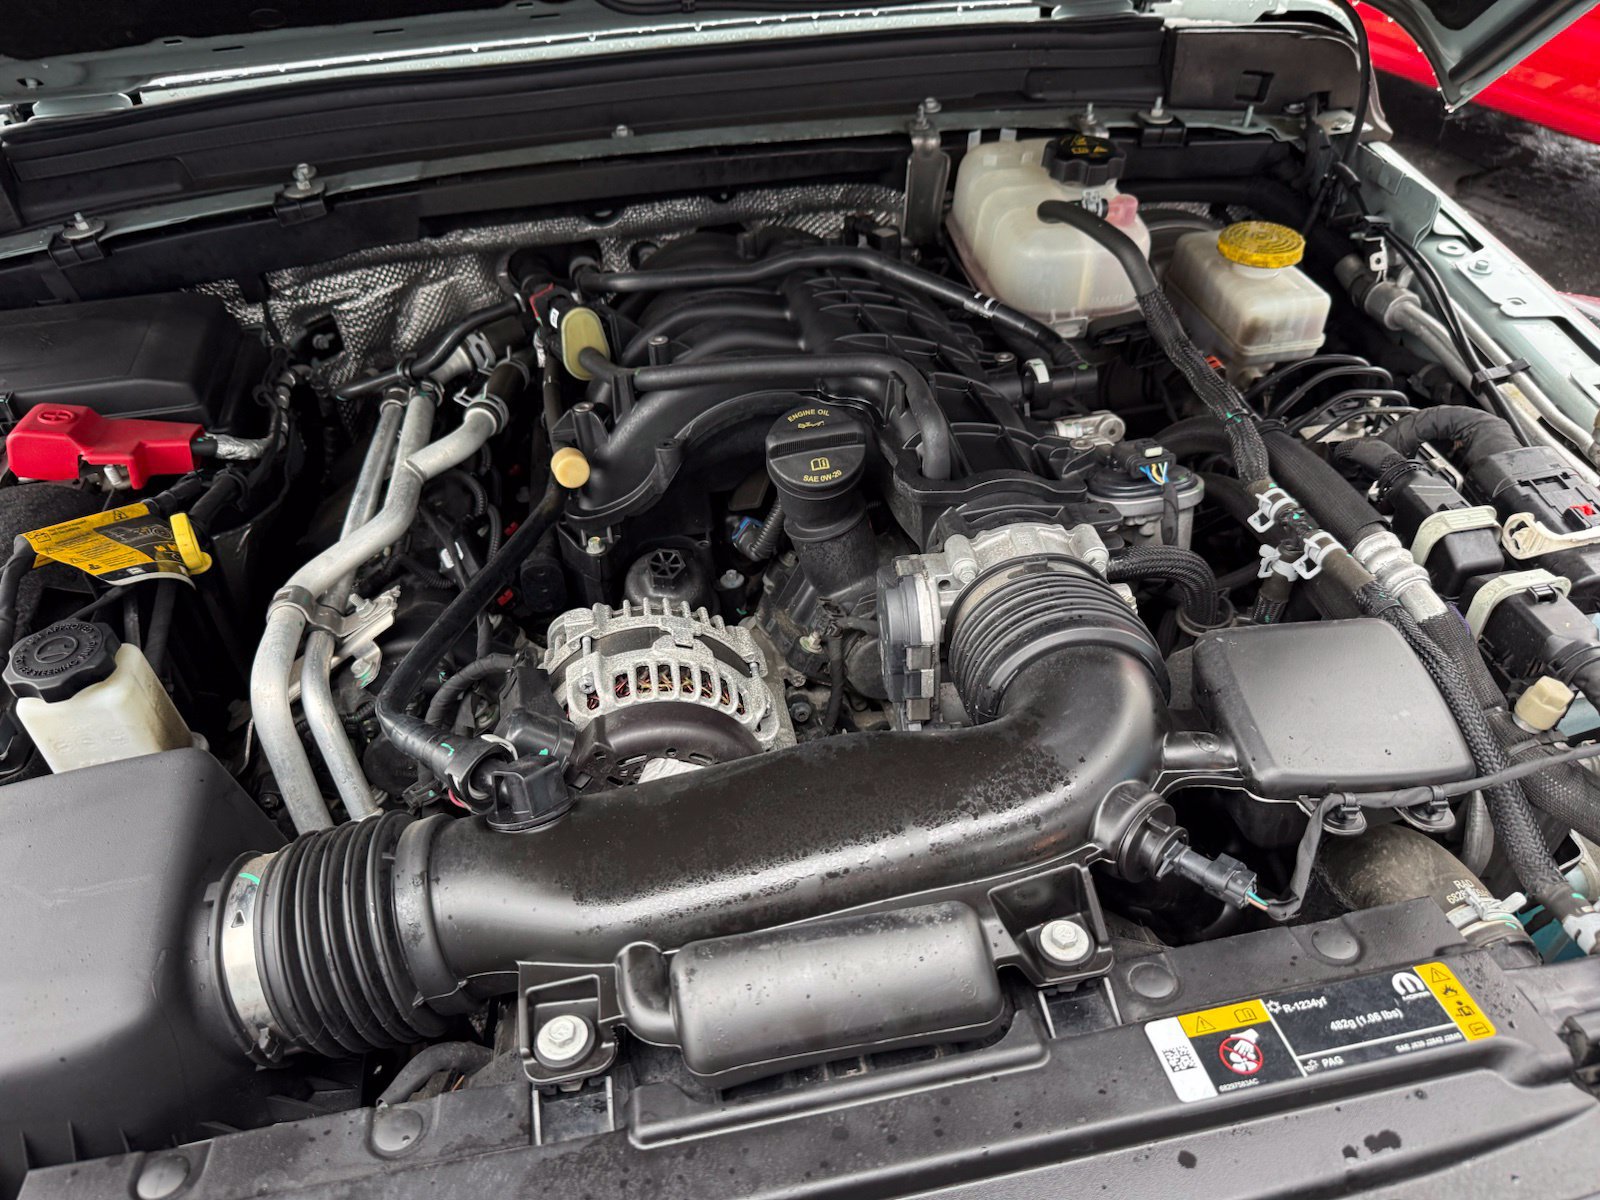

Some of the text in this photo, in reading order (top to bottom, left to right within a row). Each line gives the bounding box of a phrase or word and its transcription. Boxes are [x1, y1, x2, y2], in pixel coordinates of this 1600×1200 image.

[787, 409, 831, 423] ENGINE OIL
[803, 470, 842, 482] SAE 0W-20
[46, 622, 93, 635] APPROVED
[30, 660, 79, 677] STEERING
[77, 640, 97, 660] FLUID
[1453, 879, 1474, 890] RAD
[1282, 996, 1328, 1014] R-1234yf
[1330, 1008, 1404, 1031] 482g (1.06 lbs)
[1321, 1055, 1345, 1068] PAG
